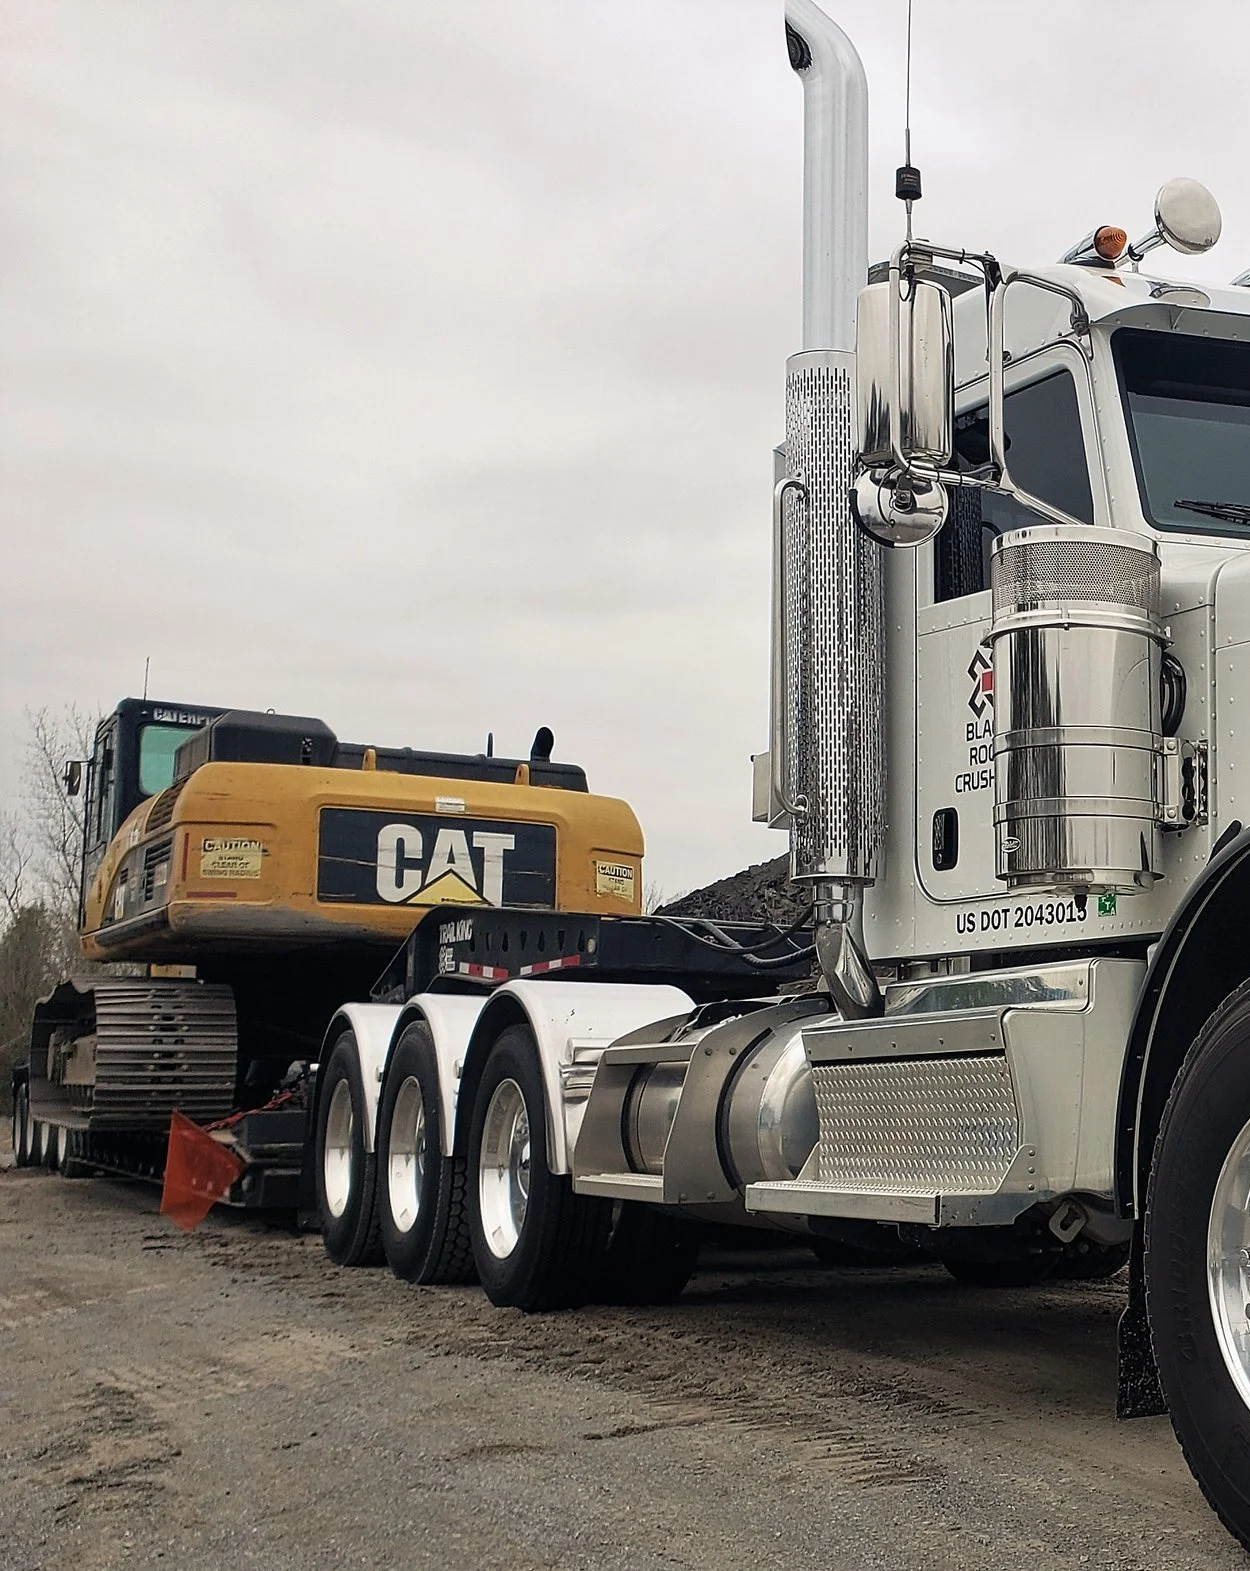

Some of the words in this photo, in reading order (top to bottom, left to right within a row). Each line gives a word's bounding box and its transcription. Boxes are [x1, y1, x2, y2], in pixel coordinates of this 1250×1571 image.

[204, 839, 261, 852] CAUTION
[376, 823, 515, 908] CAT
[598, 865, 633, 878] CAUTION
[956, 913, 976, 934] US
[981, 908, 1011, 931] DOT
